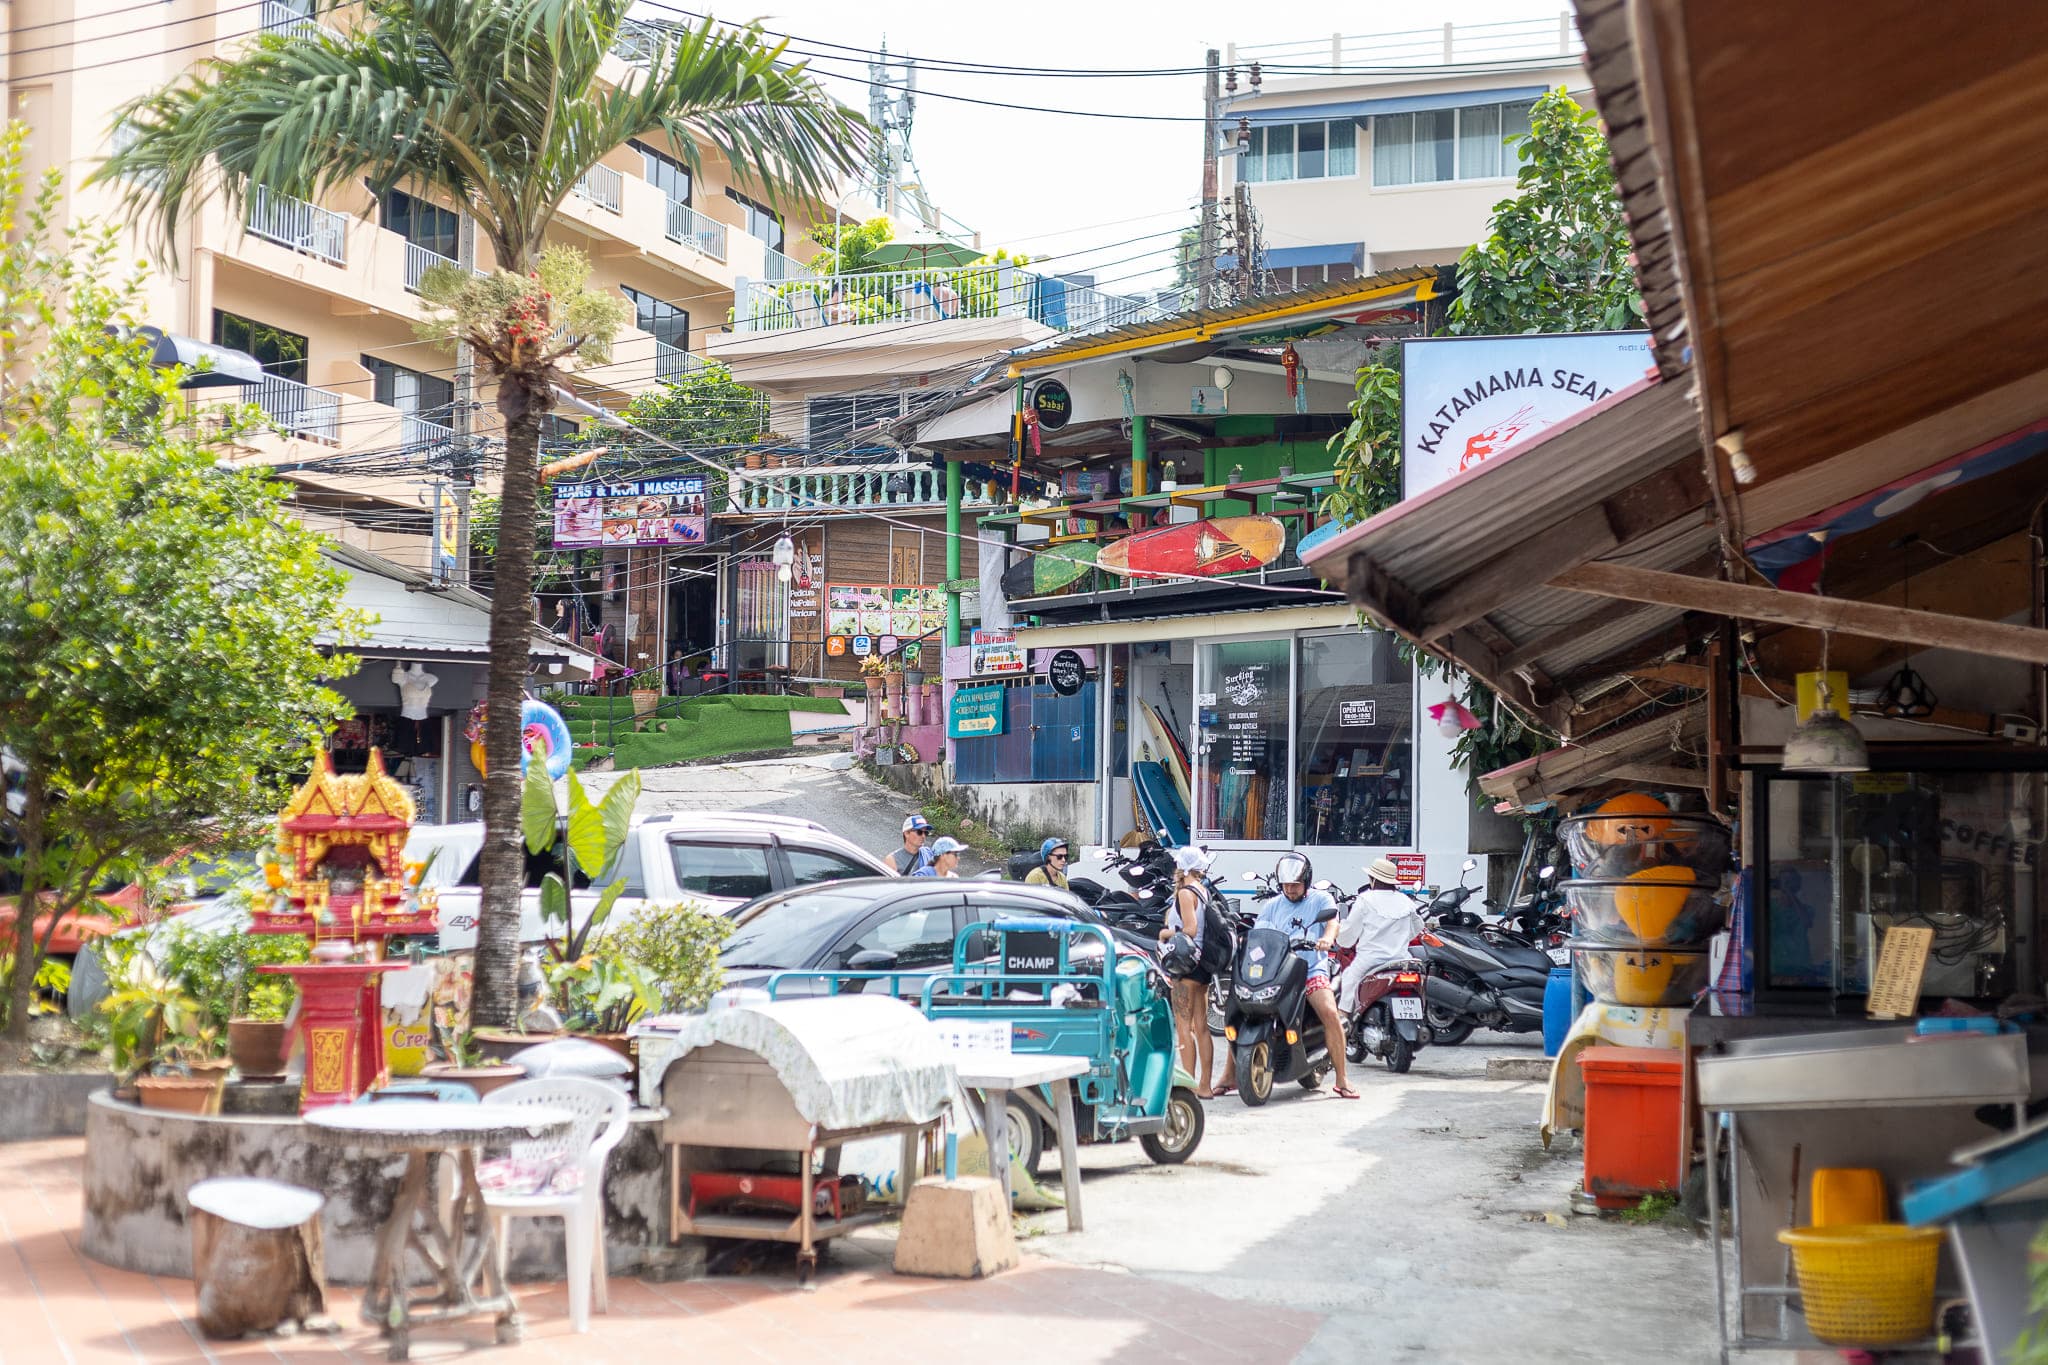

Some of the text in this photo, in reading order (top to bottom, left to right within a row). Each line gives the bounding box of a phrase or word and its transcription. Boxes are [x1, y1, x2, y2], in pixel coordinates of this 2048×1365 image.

[1038, 394, 1064, 411] Sabai
[1417, 367, 1544, 455] KATAMAMA
[596, 485, 607, 497] &
[644, 480, 703, 495] MASSAGE
[1225, 671, 1254, 685] Surfing
[1008, 957, 1055, 969] CHAMP
